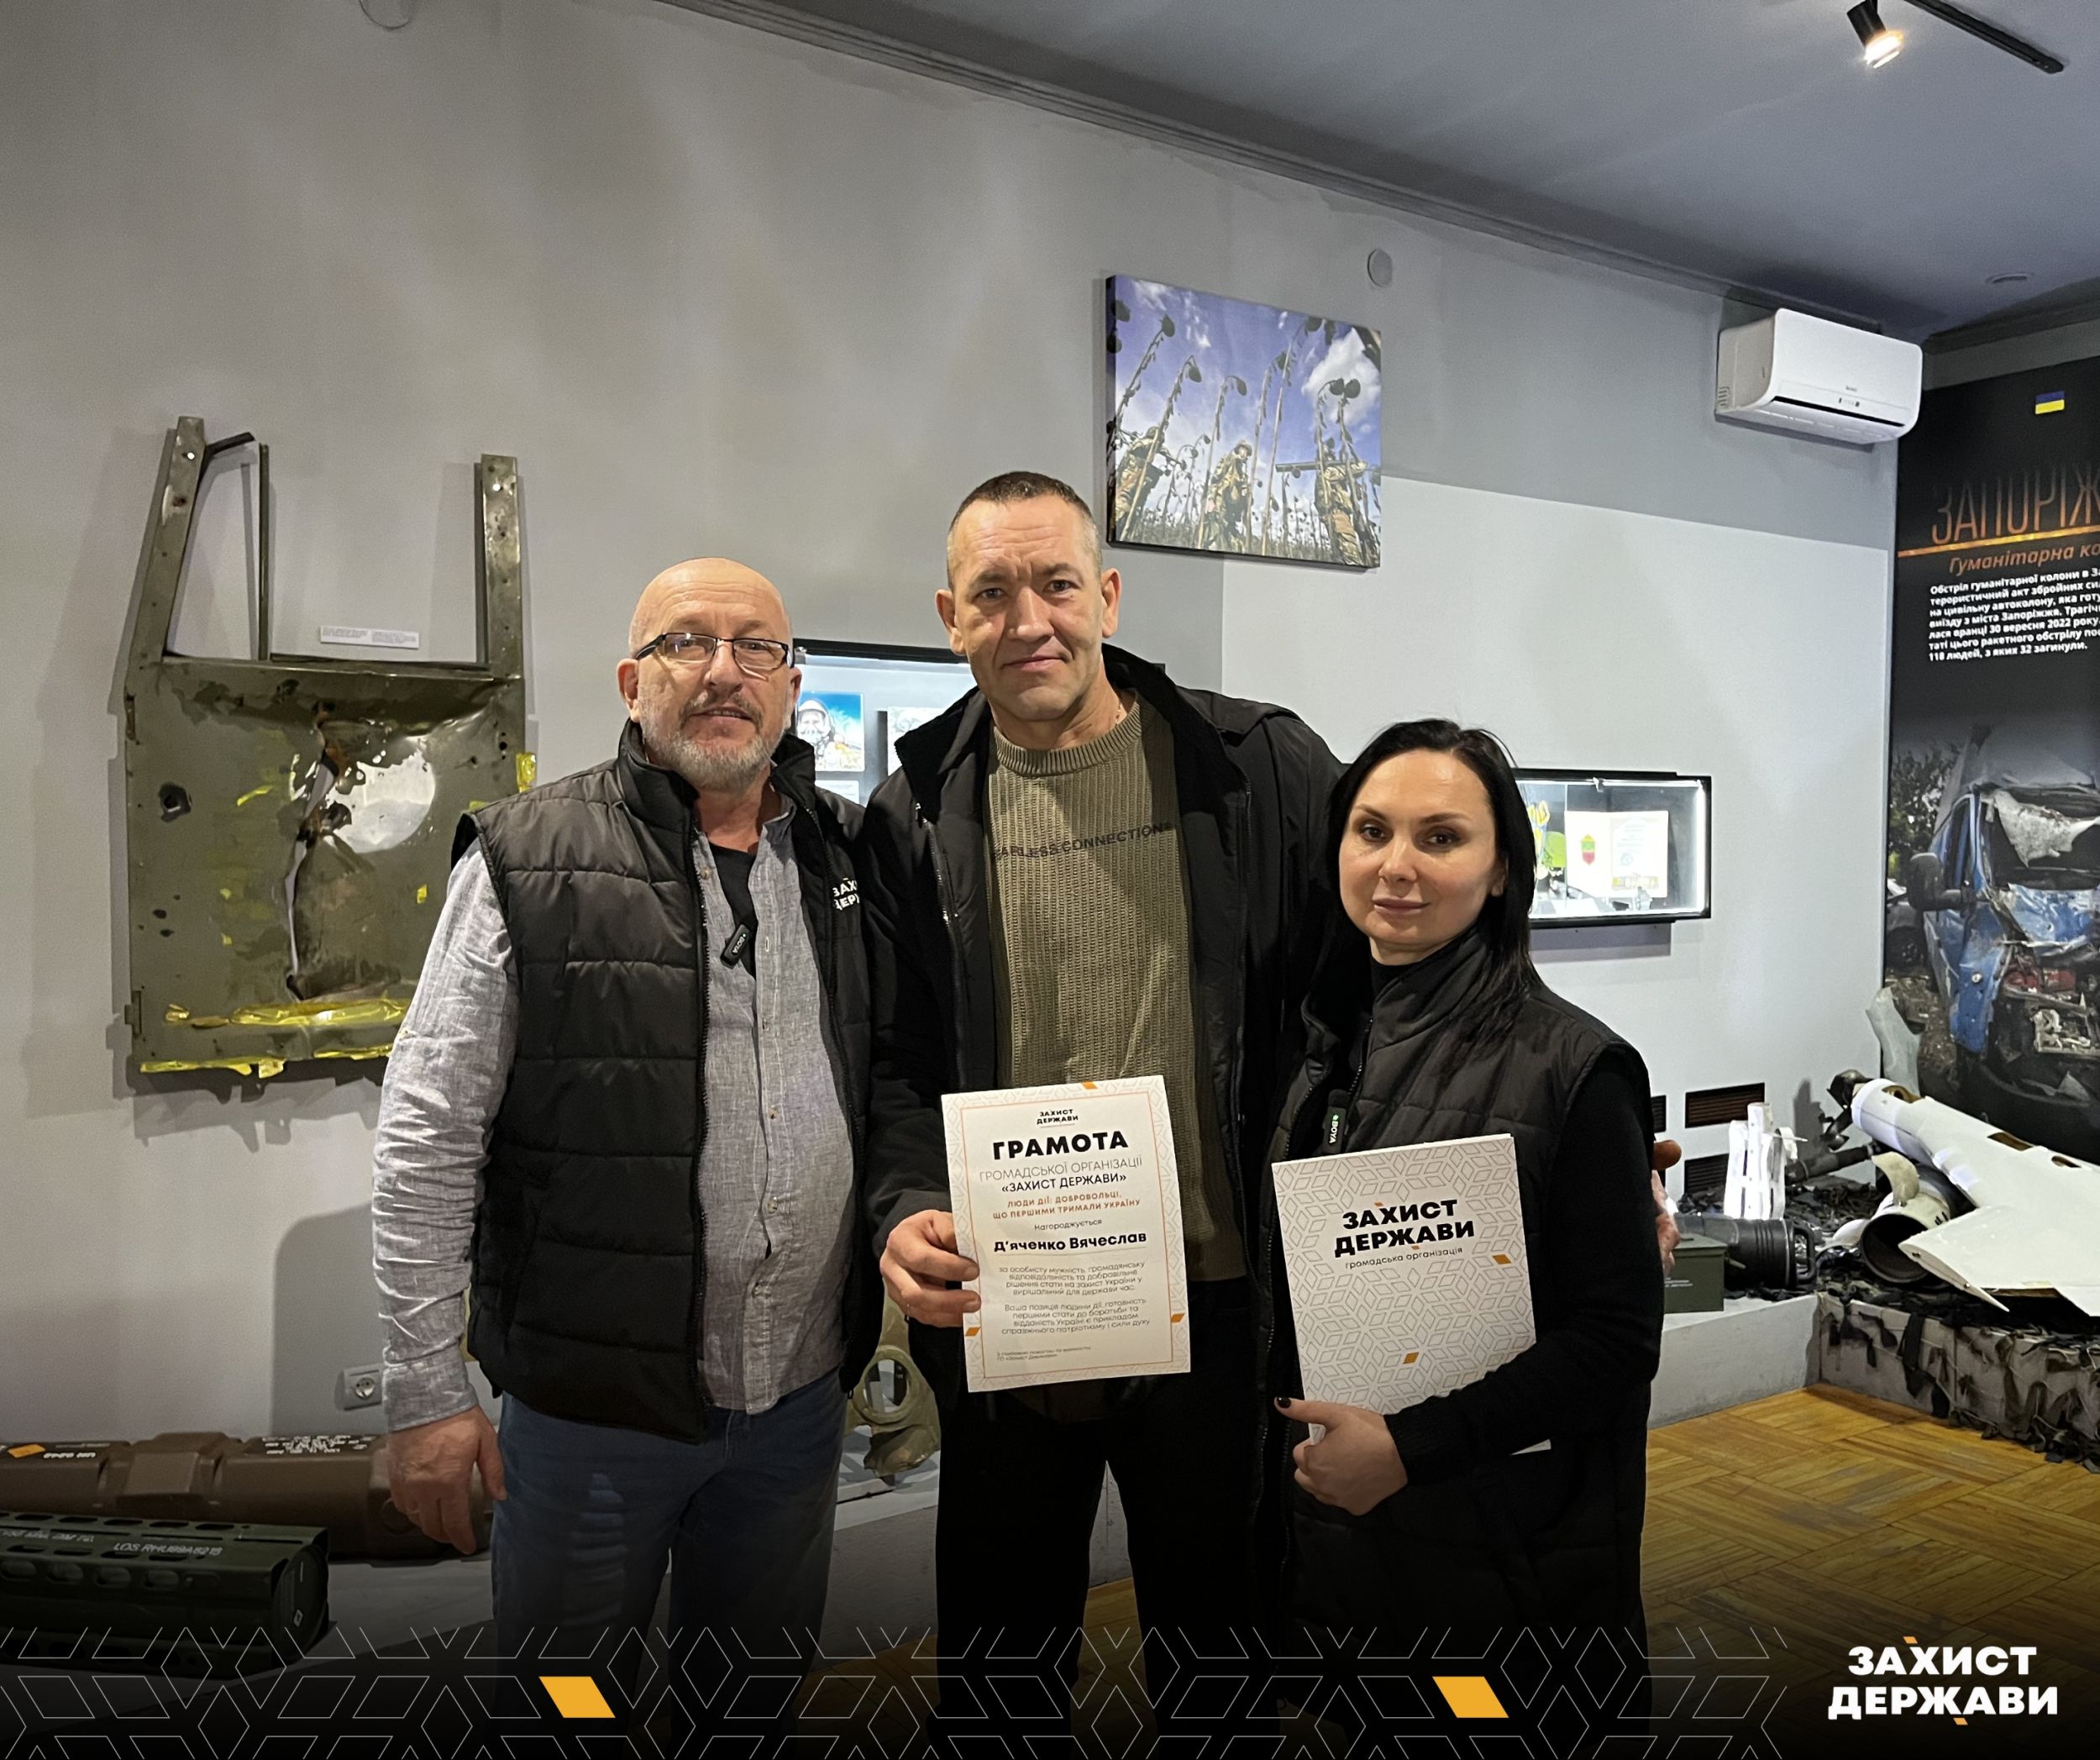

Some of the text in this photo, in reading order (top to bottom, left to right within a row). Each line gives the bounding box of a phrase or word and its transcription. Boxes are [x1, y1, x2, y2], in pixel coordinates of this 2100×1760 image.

[1949, 546, 2075, 576] Гуманітарна
[1930, 567, 2100, 595] Обстріл гуманітарної колони в З
[1930, 588, 2009, 607] терористичний
[2011, 588, 2029, 597] акт
[2031, 582, 2083, 596] збройних
[1929, 608, 1942, 617] на
[1944, 604, 1991, 617] цивільну
[1992, 598, 2056, 611] автоколону,
[2058, 595, 2077, 605] яка
[1929, 618, 1962, 628] виїзду
[1964, 617, 1970, 625] з
[1971, 613, 1999, 623] міста
[2001, 608, 2062, 622] Запоріжжя.
[1929, 630, 1951, 639] лася
[1953, 625, 1987, 638] вранці
[1989, 624, 2001, 633] 30
[2003, 622, 2045, 633] вересня
[2047, 617, 2071, 628] 2022
[1929, 640, 1948, 650] таті
[1950, 638, 1979, 650] цього
[1981, 633, 2034, 649] ракетного
[2035, 628, 2082, 642] обстрілу
[1929, 642, 2088, 661] 118 людей, з яких 32 загинули.
[1037, 1116, 1079, 1126] ДЕРЖАВИ
[1039, 1109, 1074, 1117] ЗАХИСТ
[1329, 1121, 1339, 1144] BOYA
[993, 1131, 1129, 1160] ГРАМОТА
[979, 1157, 1142, 1183] ГРОМАДСЬКОЇ ОРГАНІЗАЦІЇ
[1001, 1173, 1127, 1193] «ЗАХИСТ ДЕРЖАВИ»
[993, 1198, 1141, 1220] ЩО ПЕРШИМИ ТРИМАЛИ УКРАЇНУ
[1007, 1198, 1035, 1208] ЛЮДИ
[1034, 1218, 1102, 1232] Нагороджується
[1342, 1200, 1458, 1230] ЗАХИСТ
[1068, 1232, 1147, 1250] Вячеслав
[1334, 1220, 1475, 1258] ДЕРЖАВИ
[1010, 1265, 1047, 1274] особисту
[1089, 1262, 1146, 1273] громадянську
[1345, 1247, 1463, 1270] громадська організація
[1082, 1286, 1117, 1295] держави
[1105, 1276, 1137, 1285] України
[1089, 1306, 1127, 1317] боротьби
[1105, 1298, 1147, 1307] готовність
[1013, 1319, 1055, 1327] відданість
[1093, 1312, 1139, 1324] прикладом
[1056, 1323, 1105, 1333] патріотизму
